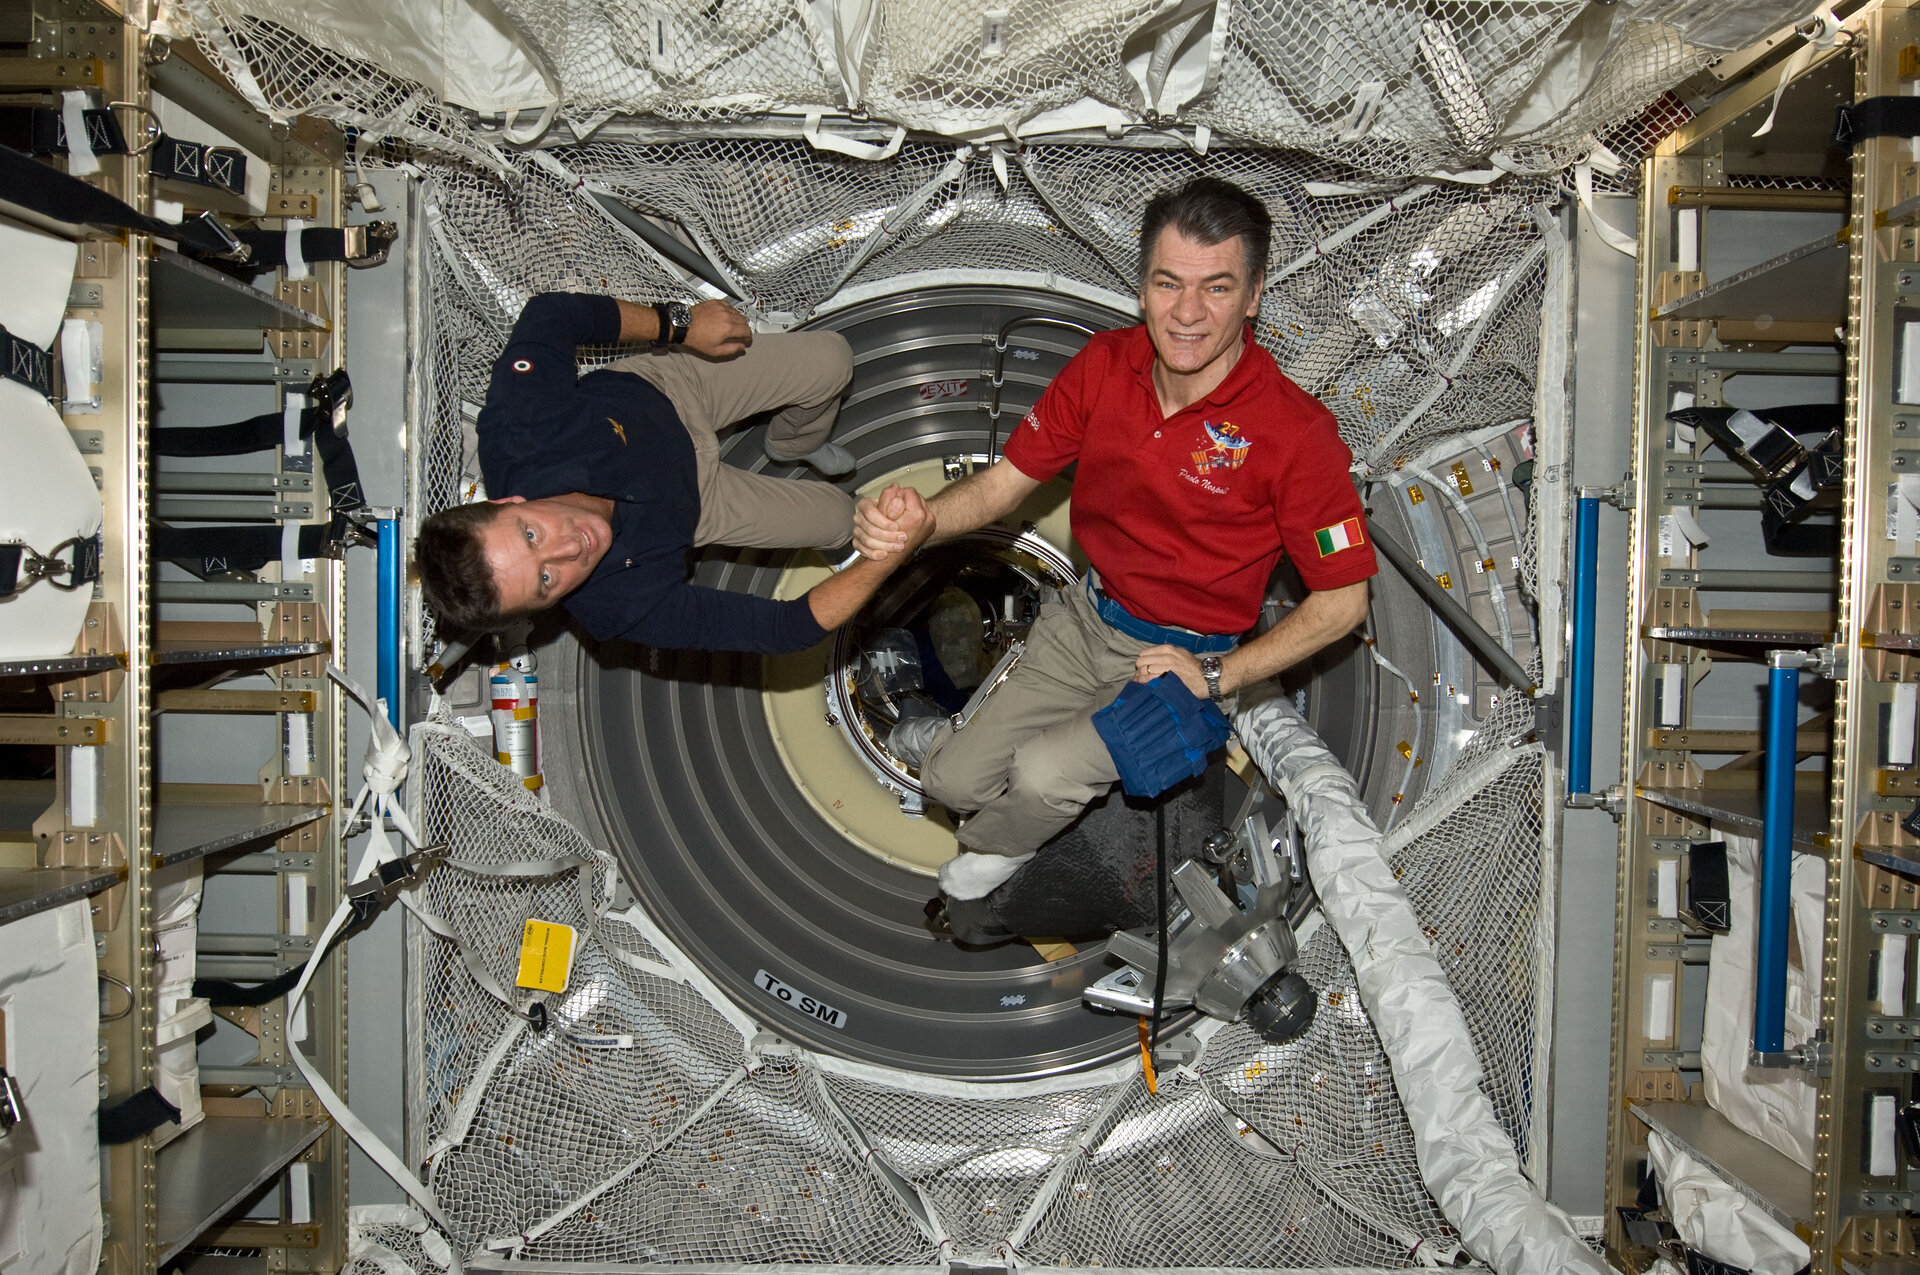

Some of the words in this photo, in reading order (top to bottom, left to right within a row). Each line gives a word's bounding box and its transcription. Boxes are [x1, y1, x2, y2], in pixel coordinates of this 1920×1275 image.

[927, 380, 960, 395] EXIT
[1027, 412, 1040, 432] esa
[1219, 421, 1240, 436] 27
[1178, 468, 1200, 484] Paolo
[1200, 479, 1230, 495] Nespoli
[765, 973, 792, 1001] To
[798, 997, 840, 1025] SM
